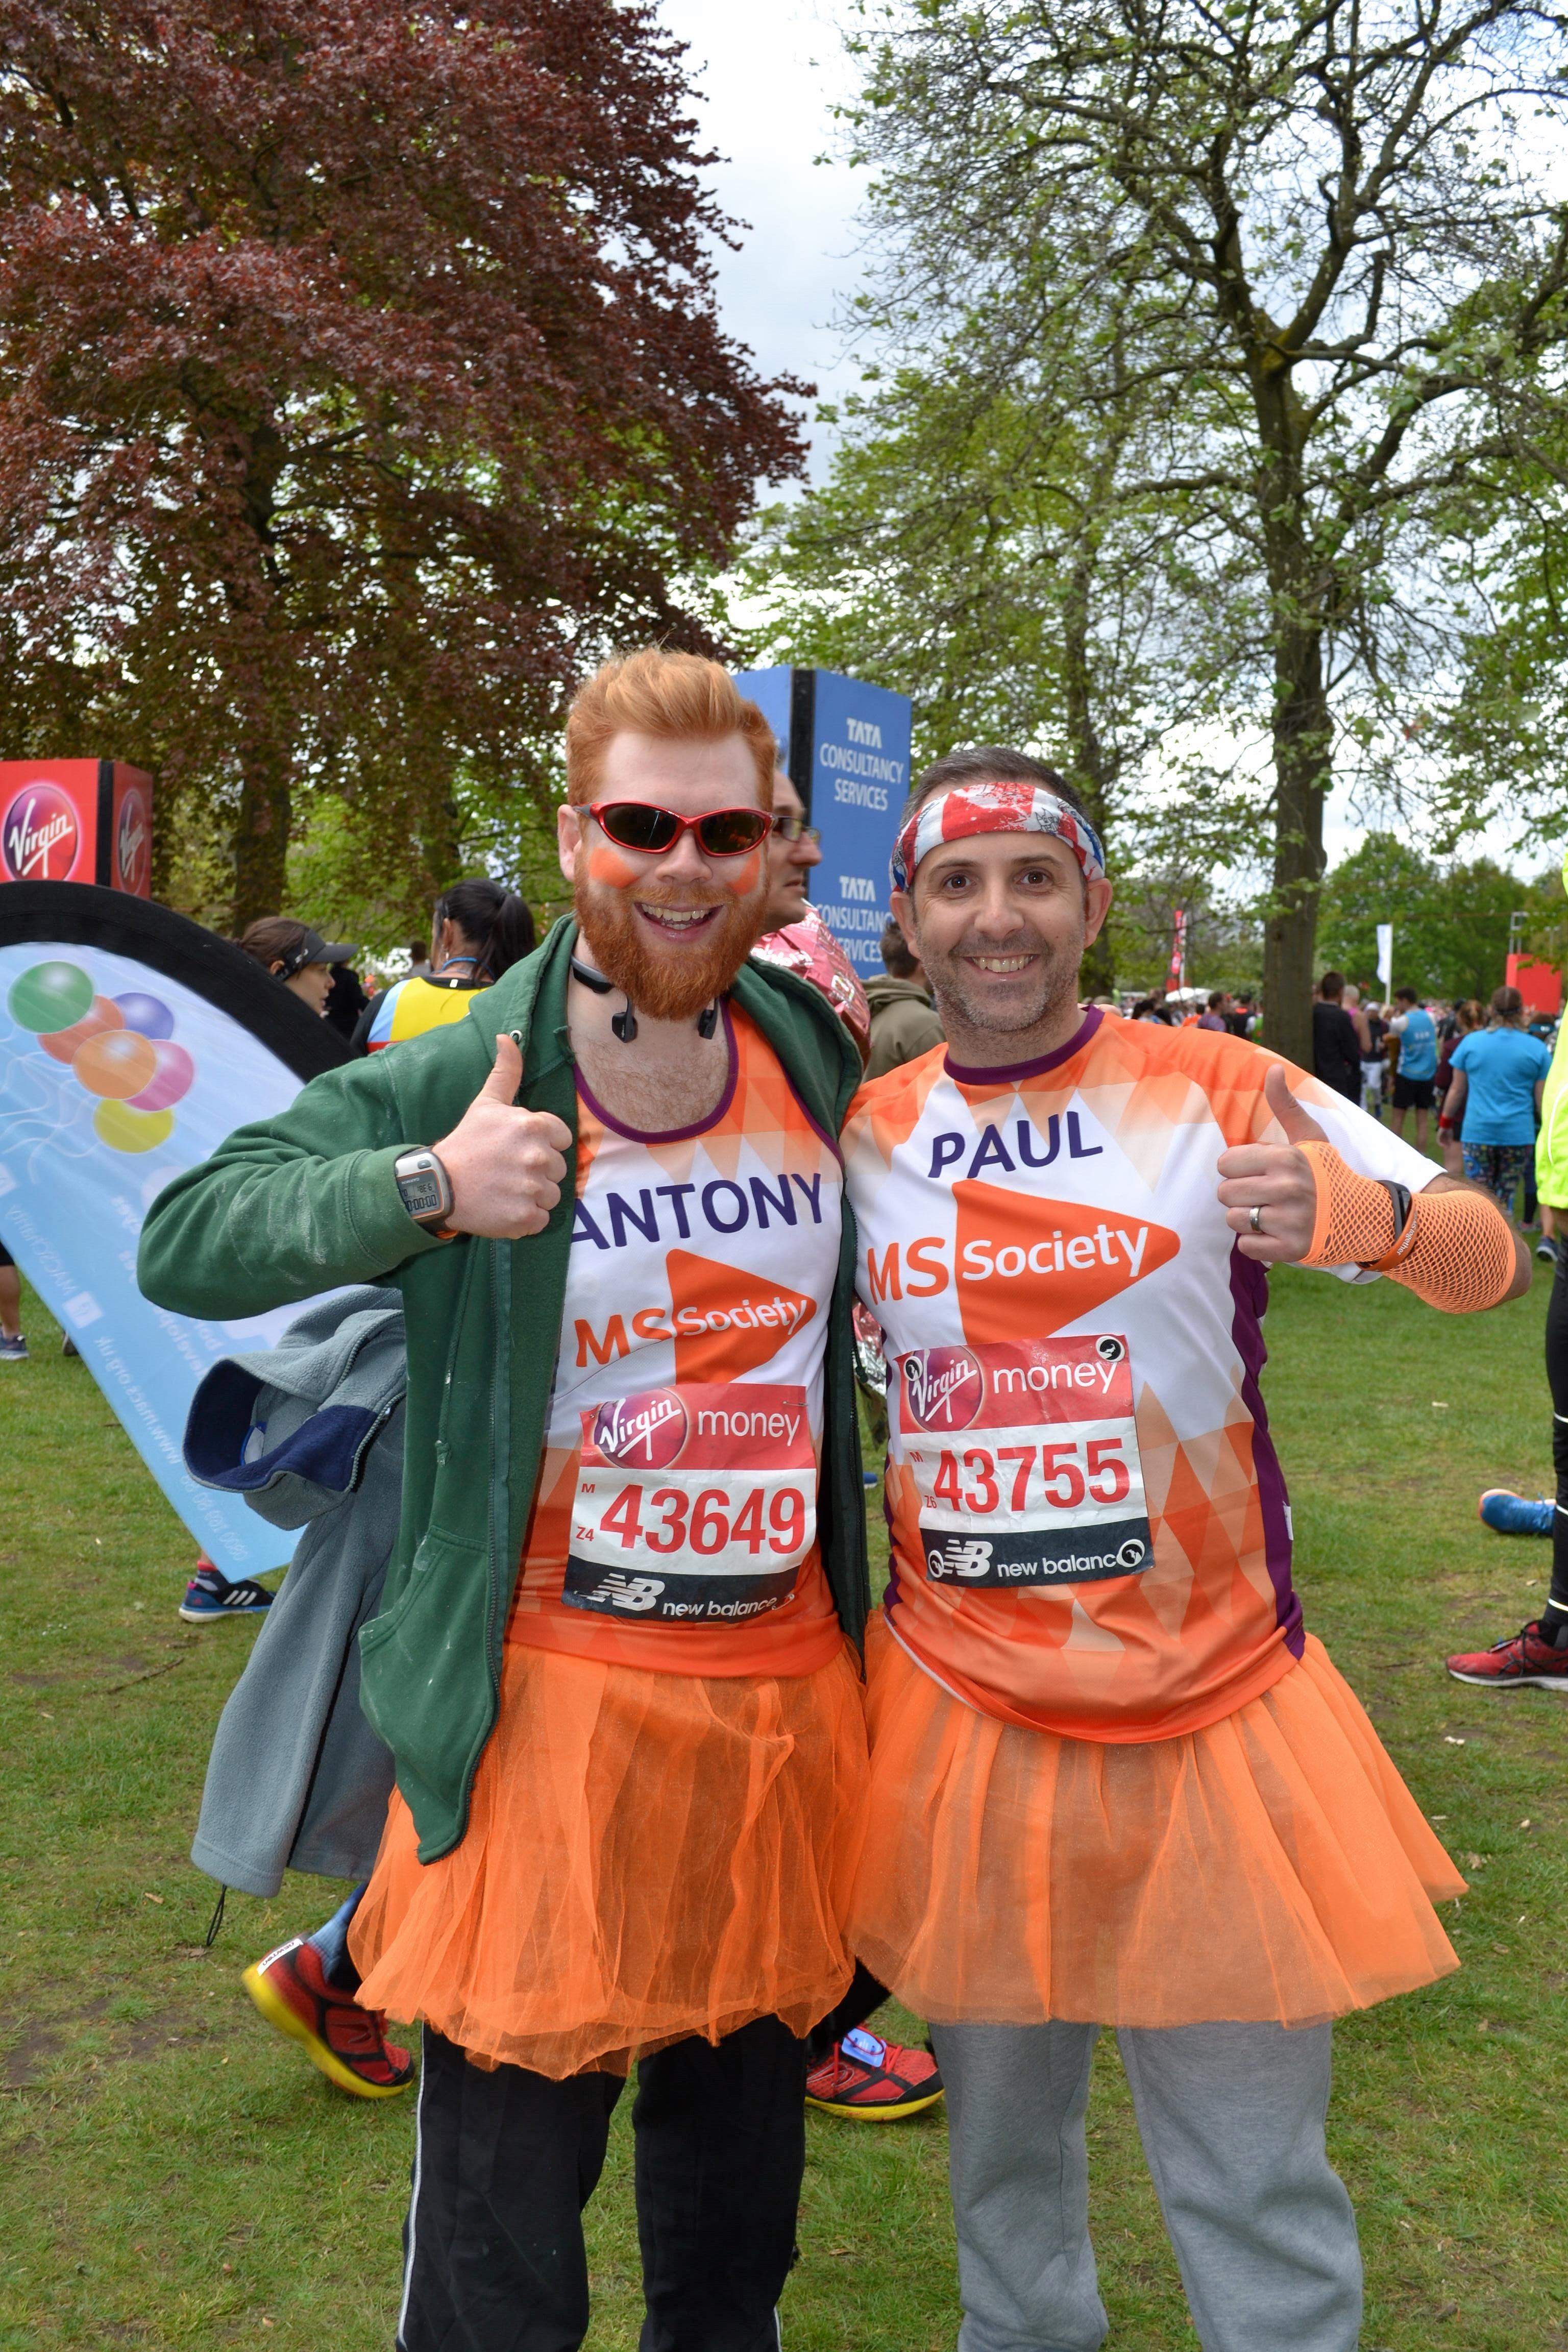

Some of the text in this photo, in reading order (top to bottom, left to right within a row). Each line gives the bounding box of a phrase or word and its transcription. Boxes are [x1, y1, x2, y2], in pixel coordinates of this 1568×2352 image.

[846, 717, 883, 749] TATA
[820, 743, 904, 784] CONSULTANCY
[834, 778, 888, 811] SERVICES
[9, 798, 73, 878] Virgin
[840, 875, 876, 902] TATA
[927, 1111, 1103, 1179] PAUL
[572, 1173, 822, 1250] ANTONY
[1397, 1229, 1414, 1255] together
[867, 1224, 1148, 1305] MS Society
[574, 1297, 807, 1367] MS Society
[912, 1348, 1116, 1423] Virgin money
[599, 1398, 800, 1460] Virgin money
[910, 1451, 924, 1463] M
[933, 1437, 1131, 1513] 43755
[581, 1484, 595, 1493] M
[925, 1496, 938, 1509] Z6
[576, 1526, 594, 1541] Z4
[599, 1484, 806, 1555] 43649
[997, 1561, 1038, 1578] new
[1043, 1554, 1117, 1575] balanc
[663, 1602, 703, 1616] new
[706, 1597, 777, 1616] balance
